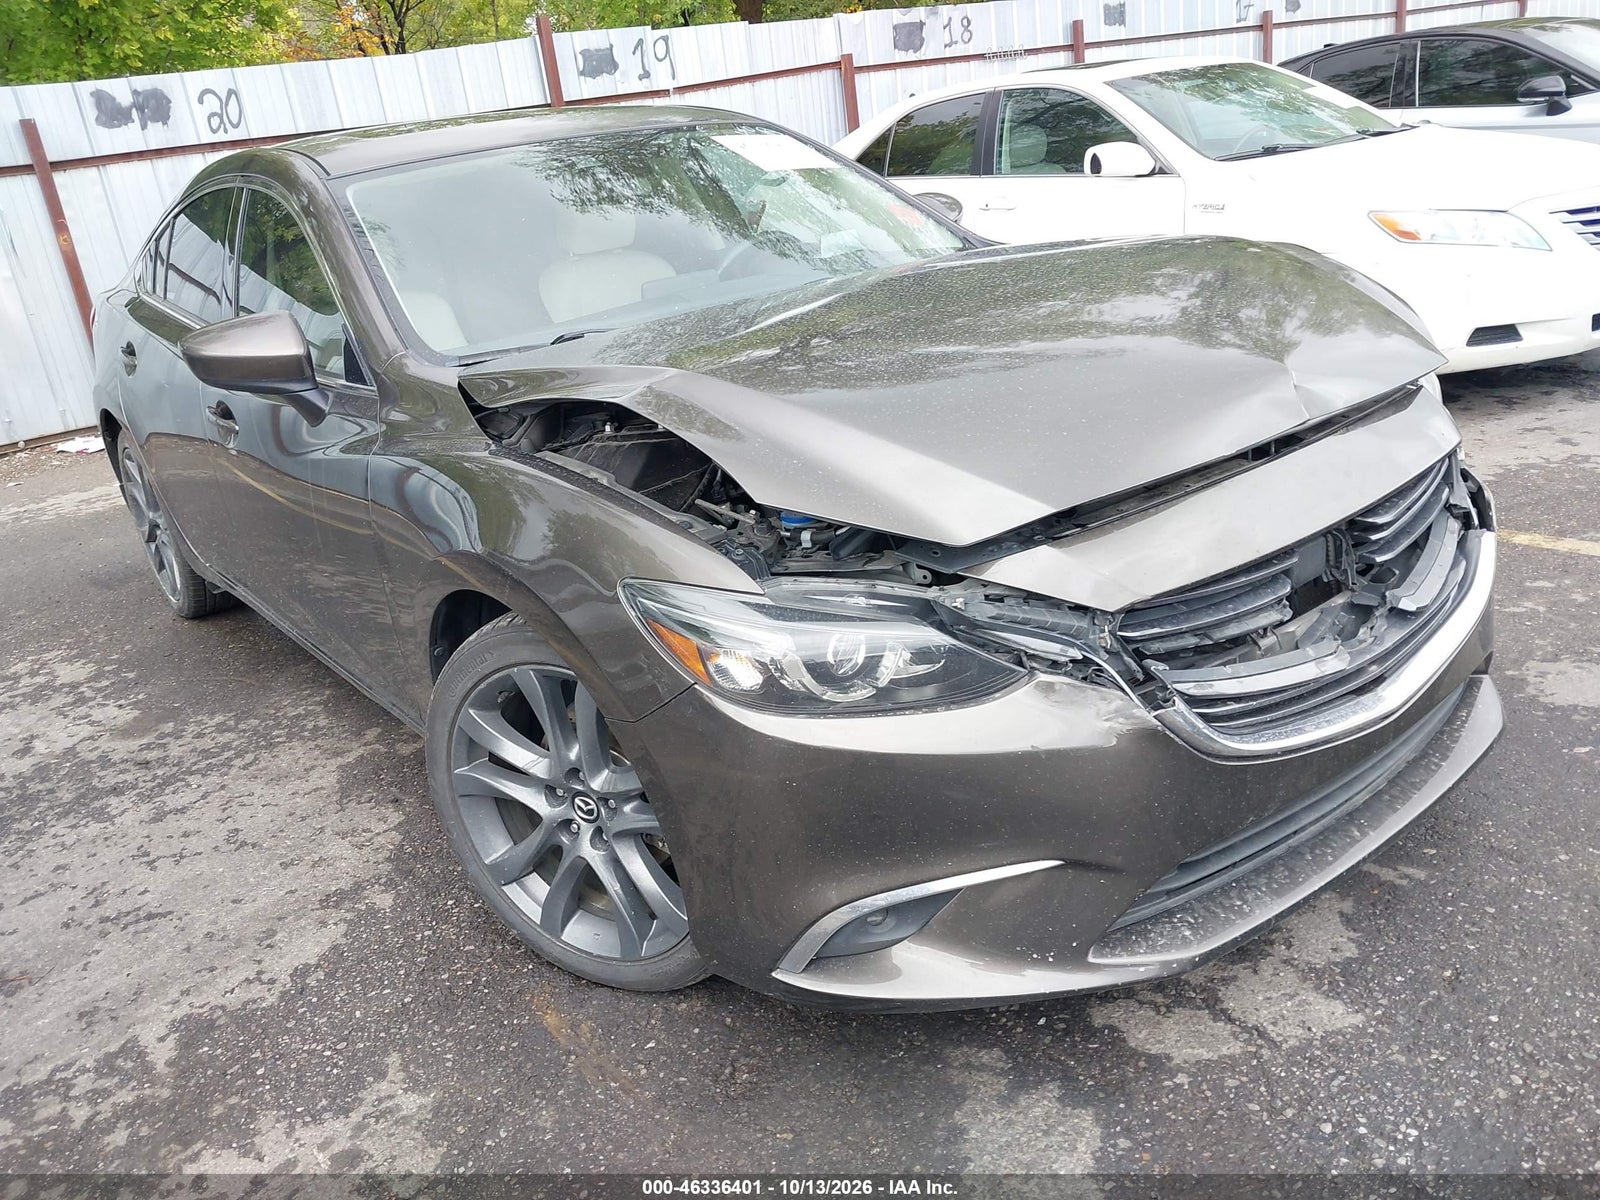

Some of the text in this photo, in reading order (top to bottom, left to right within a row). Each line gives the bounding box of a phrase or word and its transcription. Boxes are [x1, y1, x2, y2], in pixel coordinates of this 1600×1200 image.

[942, 15, 973, 48] 18
[631, 35, 676, 81] 19
[197, 87, 243, 135] 20
